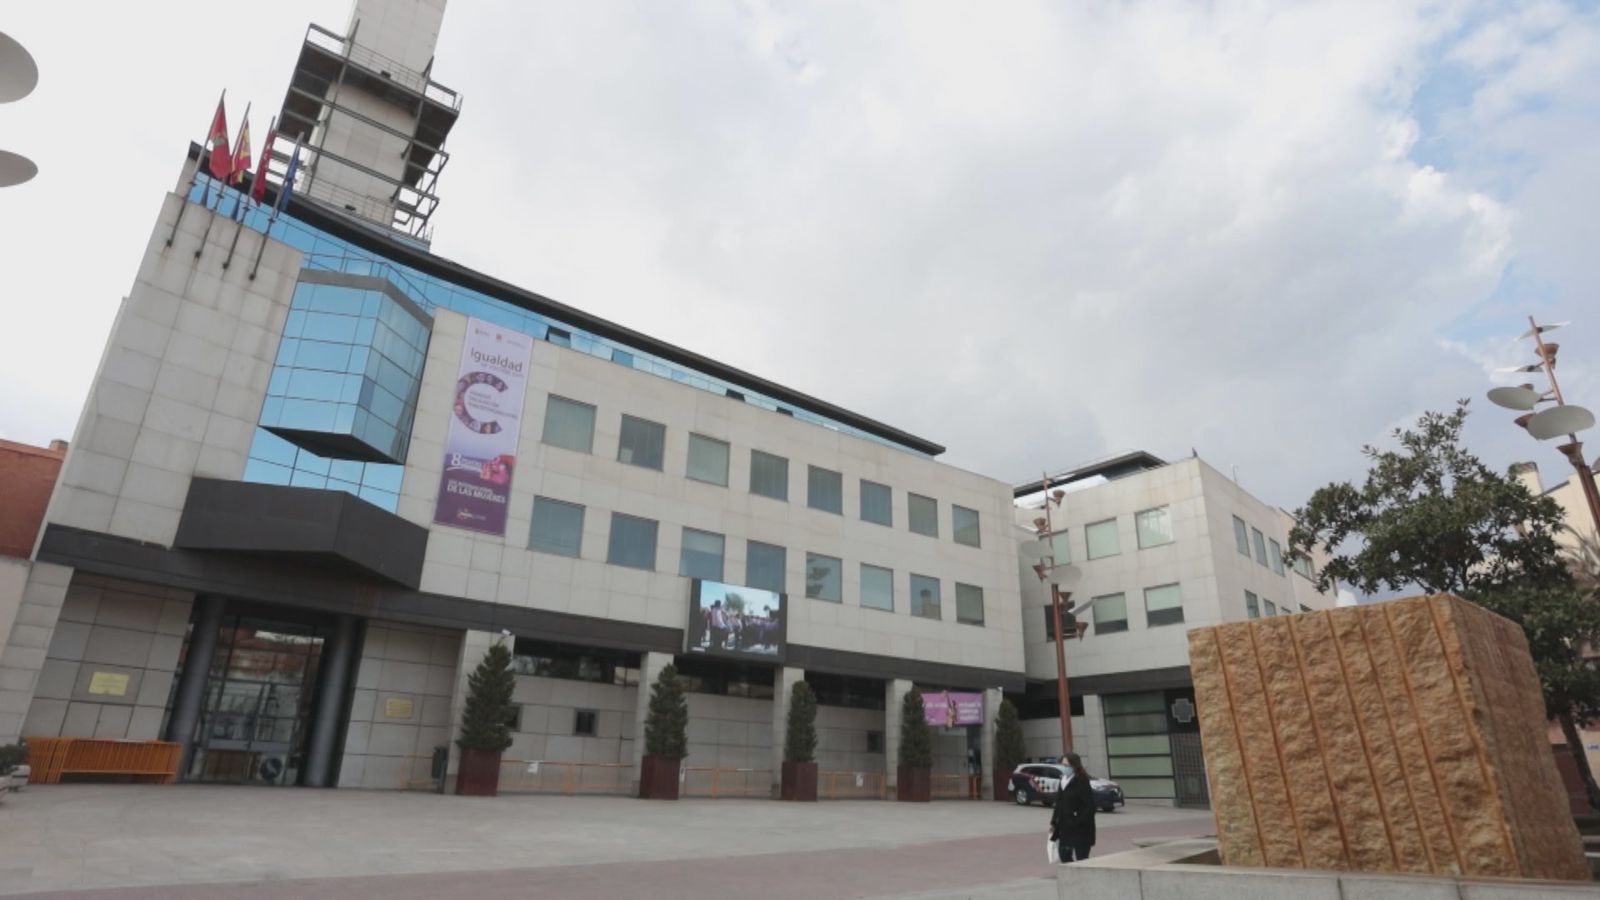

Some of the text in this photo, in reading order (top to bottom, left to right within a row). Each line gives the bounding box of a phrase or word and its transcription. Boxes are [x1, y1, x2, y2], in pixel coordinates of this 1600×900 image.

[470, 347, 522, 372] Igualdad
[451, 452, 461, 467] 8
[447, 483, 457, 493] DE
[459, 486, 472, 496] LAS
[473, 491, 505, 504] MUJERES
